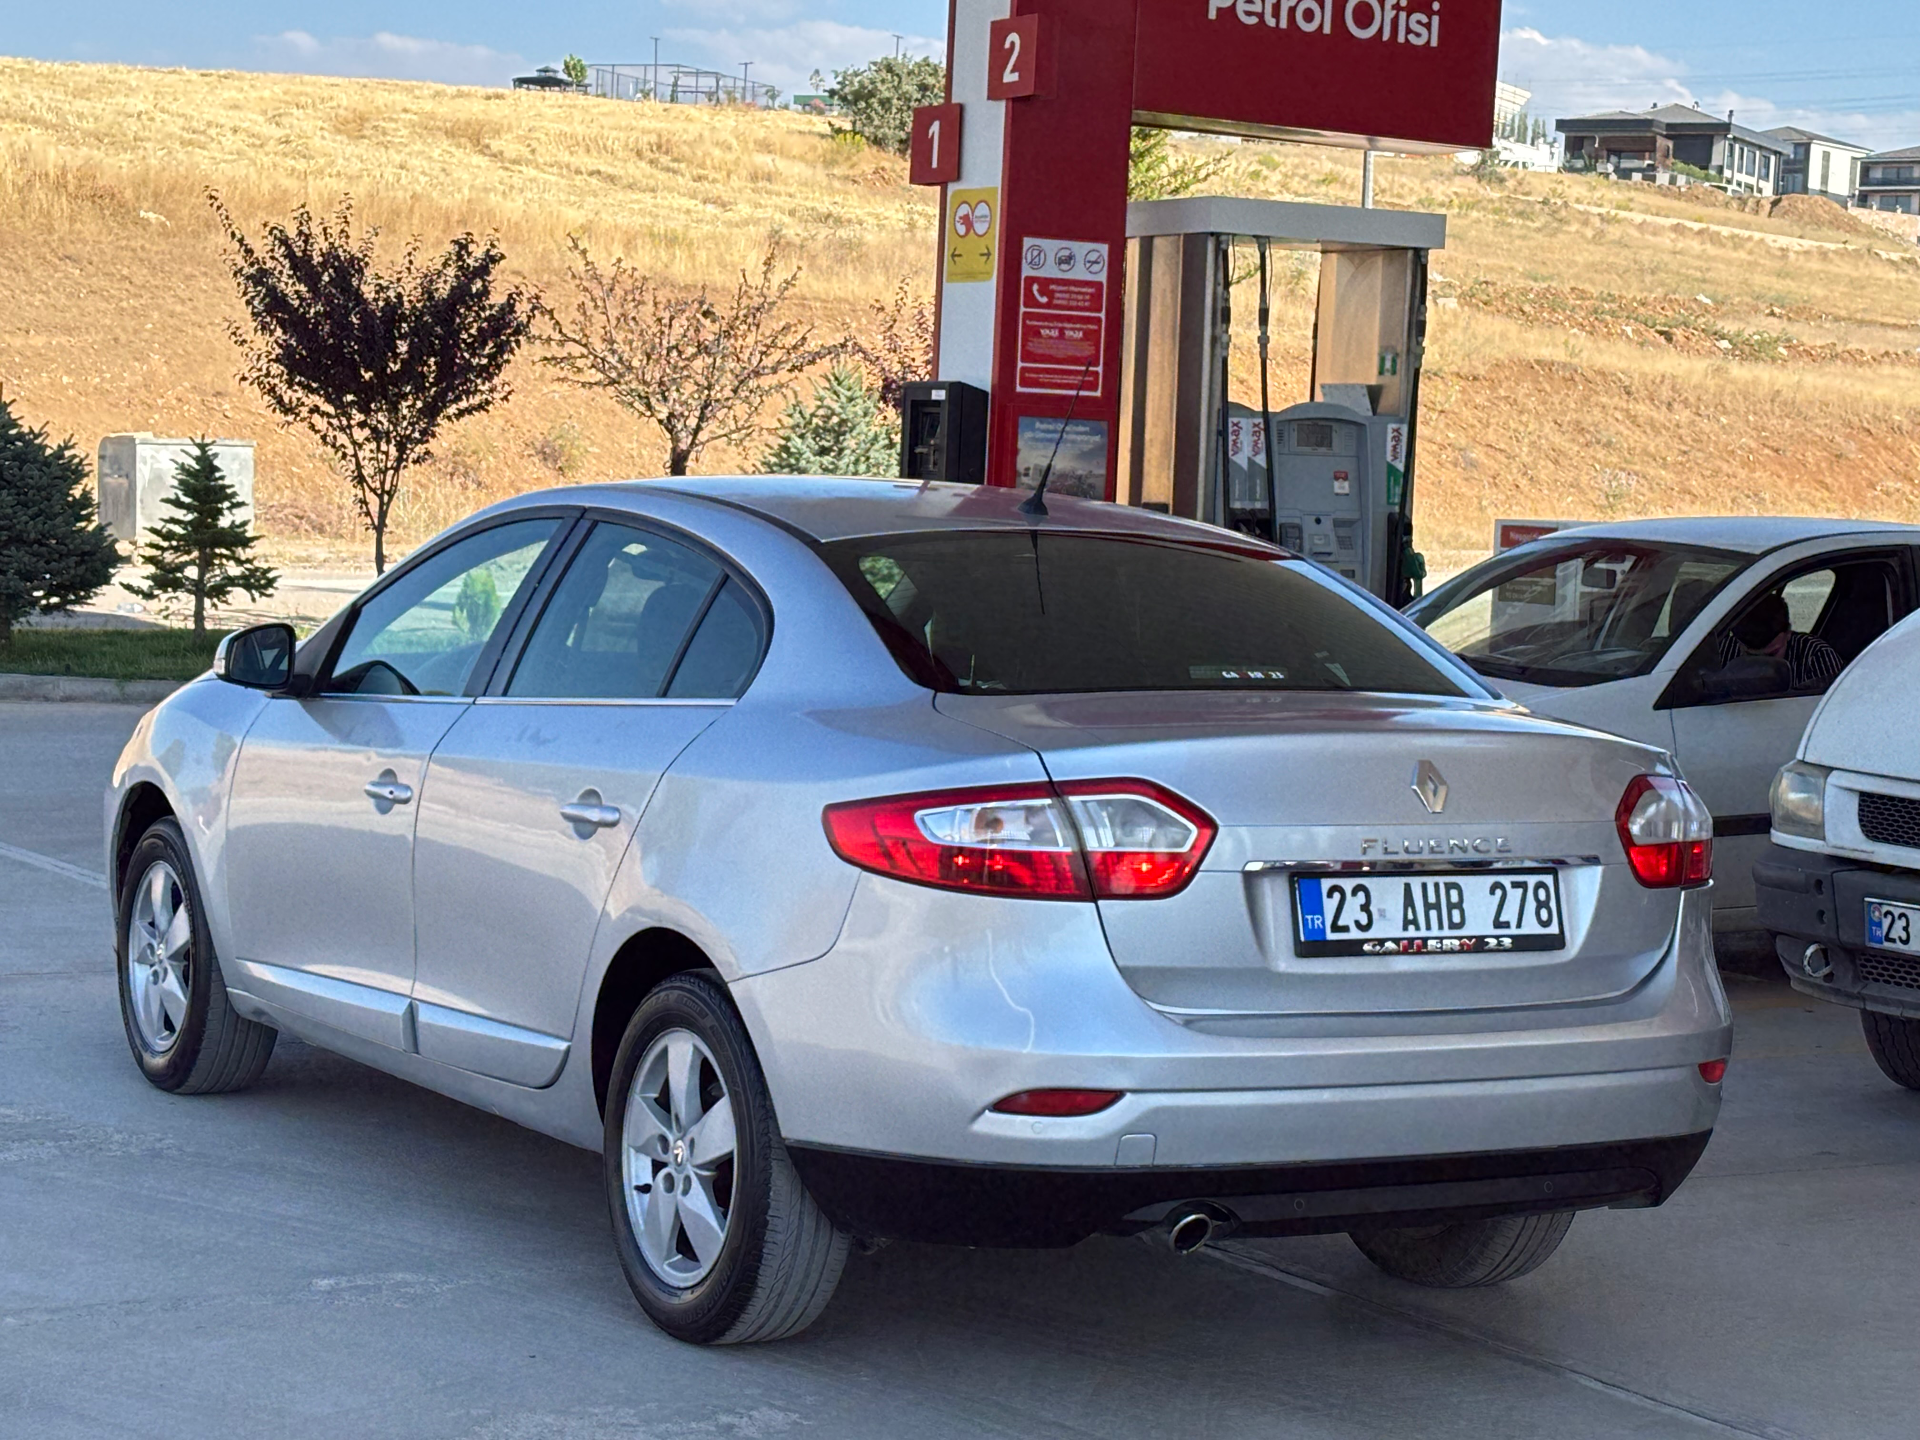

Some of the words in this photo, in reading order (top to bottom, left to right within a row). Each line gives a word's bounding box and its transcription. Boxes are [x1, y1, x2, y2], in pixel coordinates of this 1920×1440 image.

[1344, 0, 1440, 47] Ofisi
[1003, 32, 1020, 84] 2
[928, 119, 940, 170] 1
[1361, 836, 1514, 856] FLUENCE
[1305, 914, 1323, 930] TR
[1326, 883, 1374, 934] 23
[1402, 881, 1467, 932] AHB
[1489, 880, 1554, 930] 278
[1871, 926, 1882, 937] TR
[1883, 910, 1910, 945] 23
[1483, 936, 1513, 950] 23
